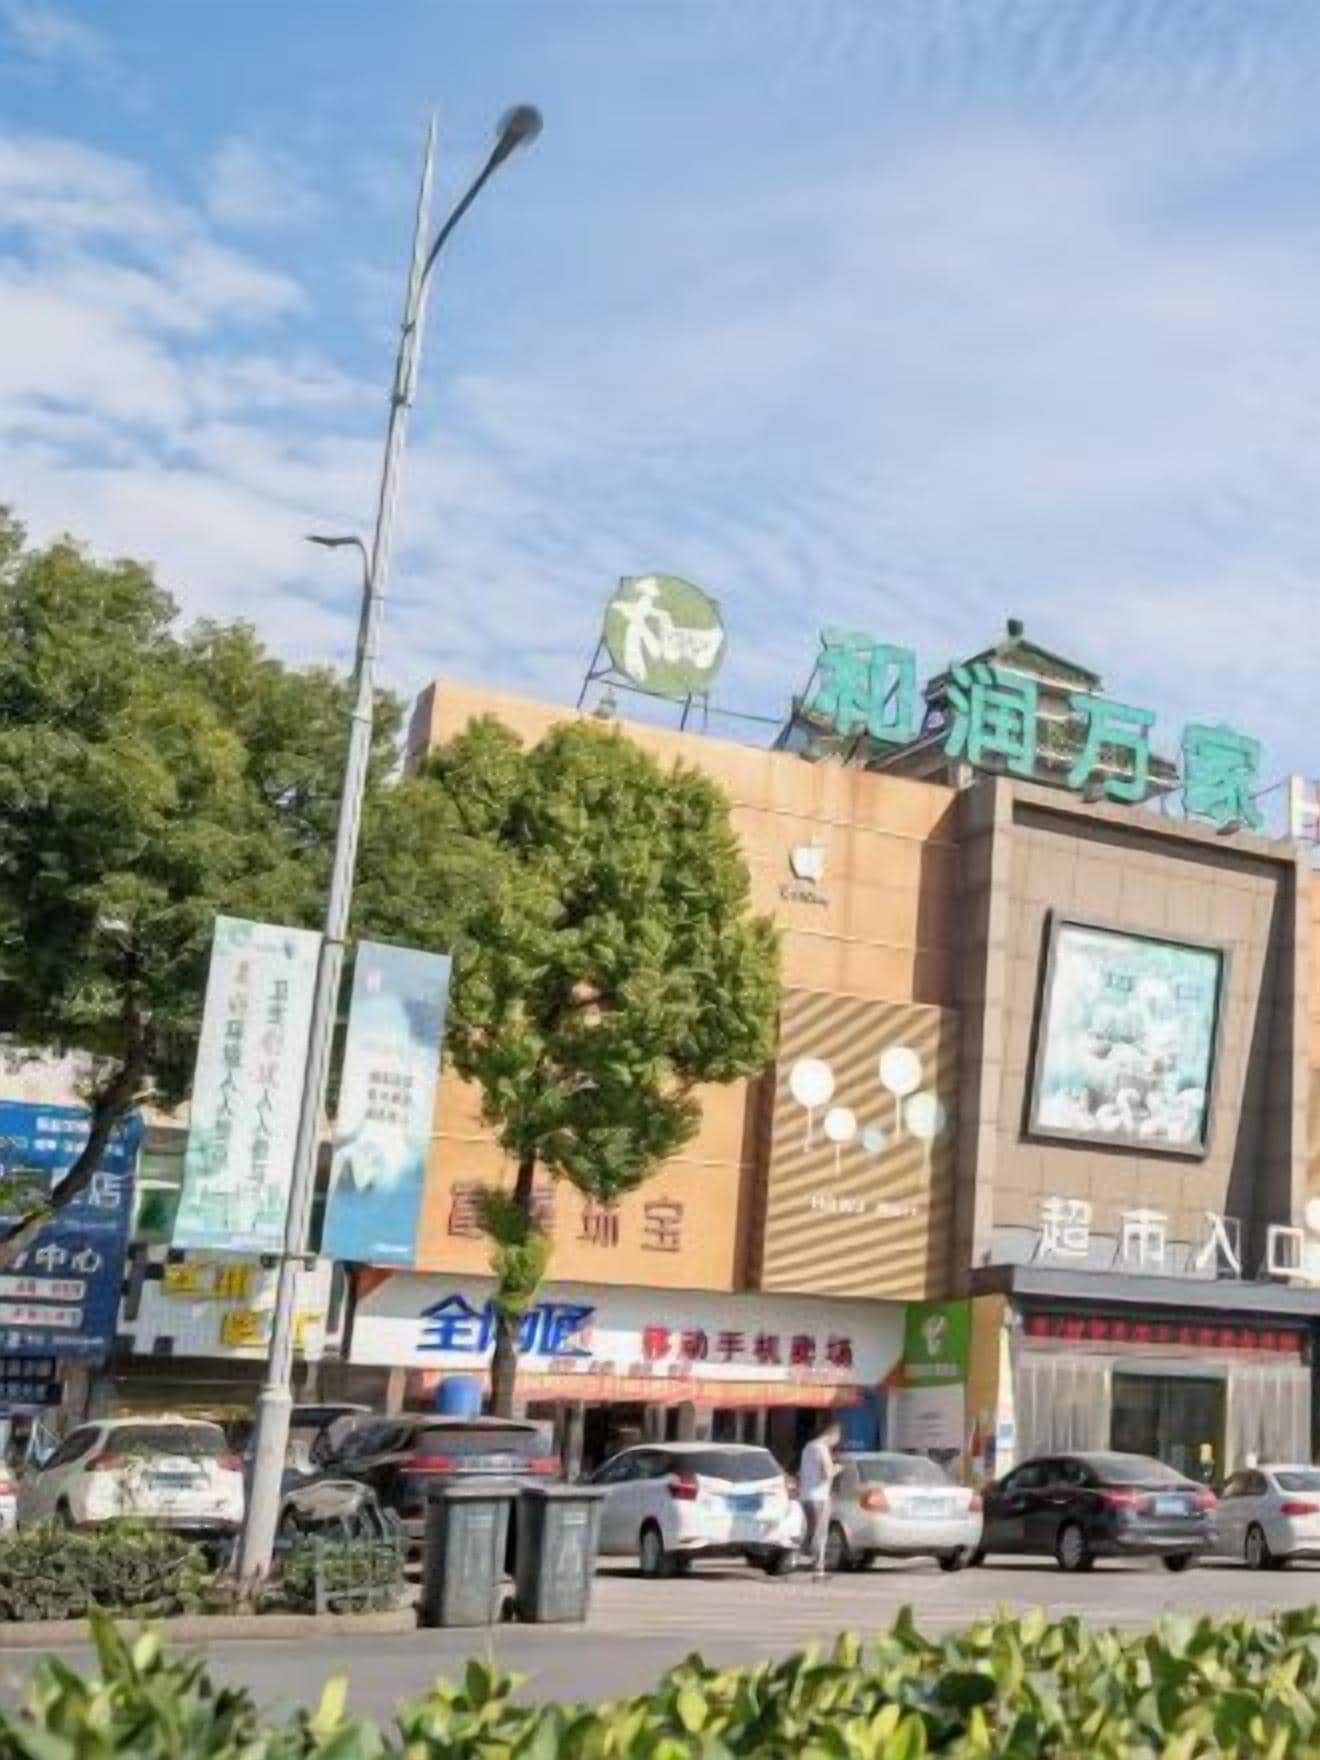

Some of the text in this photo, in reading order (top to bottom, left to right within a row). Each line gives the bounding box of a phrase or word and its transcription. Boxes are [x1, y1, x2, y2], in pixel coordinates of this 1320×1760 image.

[803, 626, 1264, 831] 和润万家
[1037, 1196, 1304, 1279] 超市入口
[641, 1324, 853, 1368] 移动手机卖场
